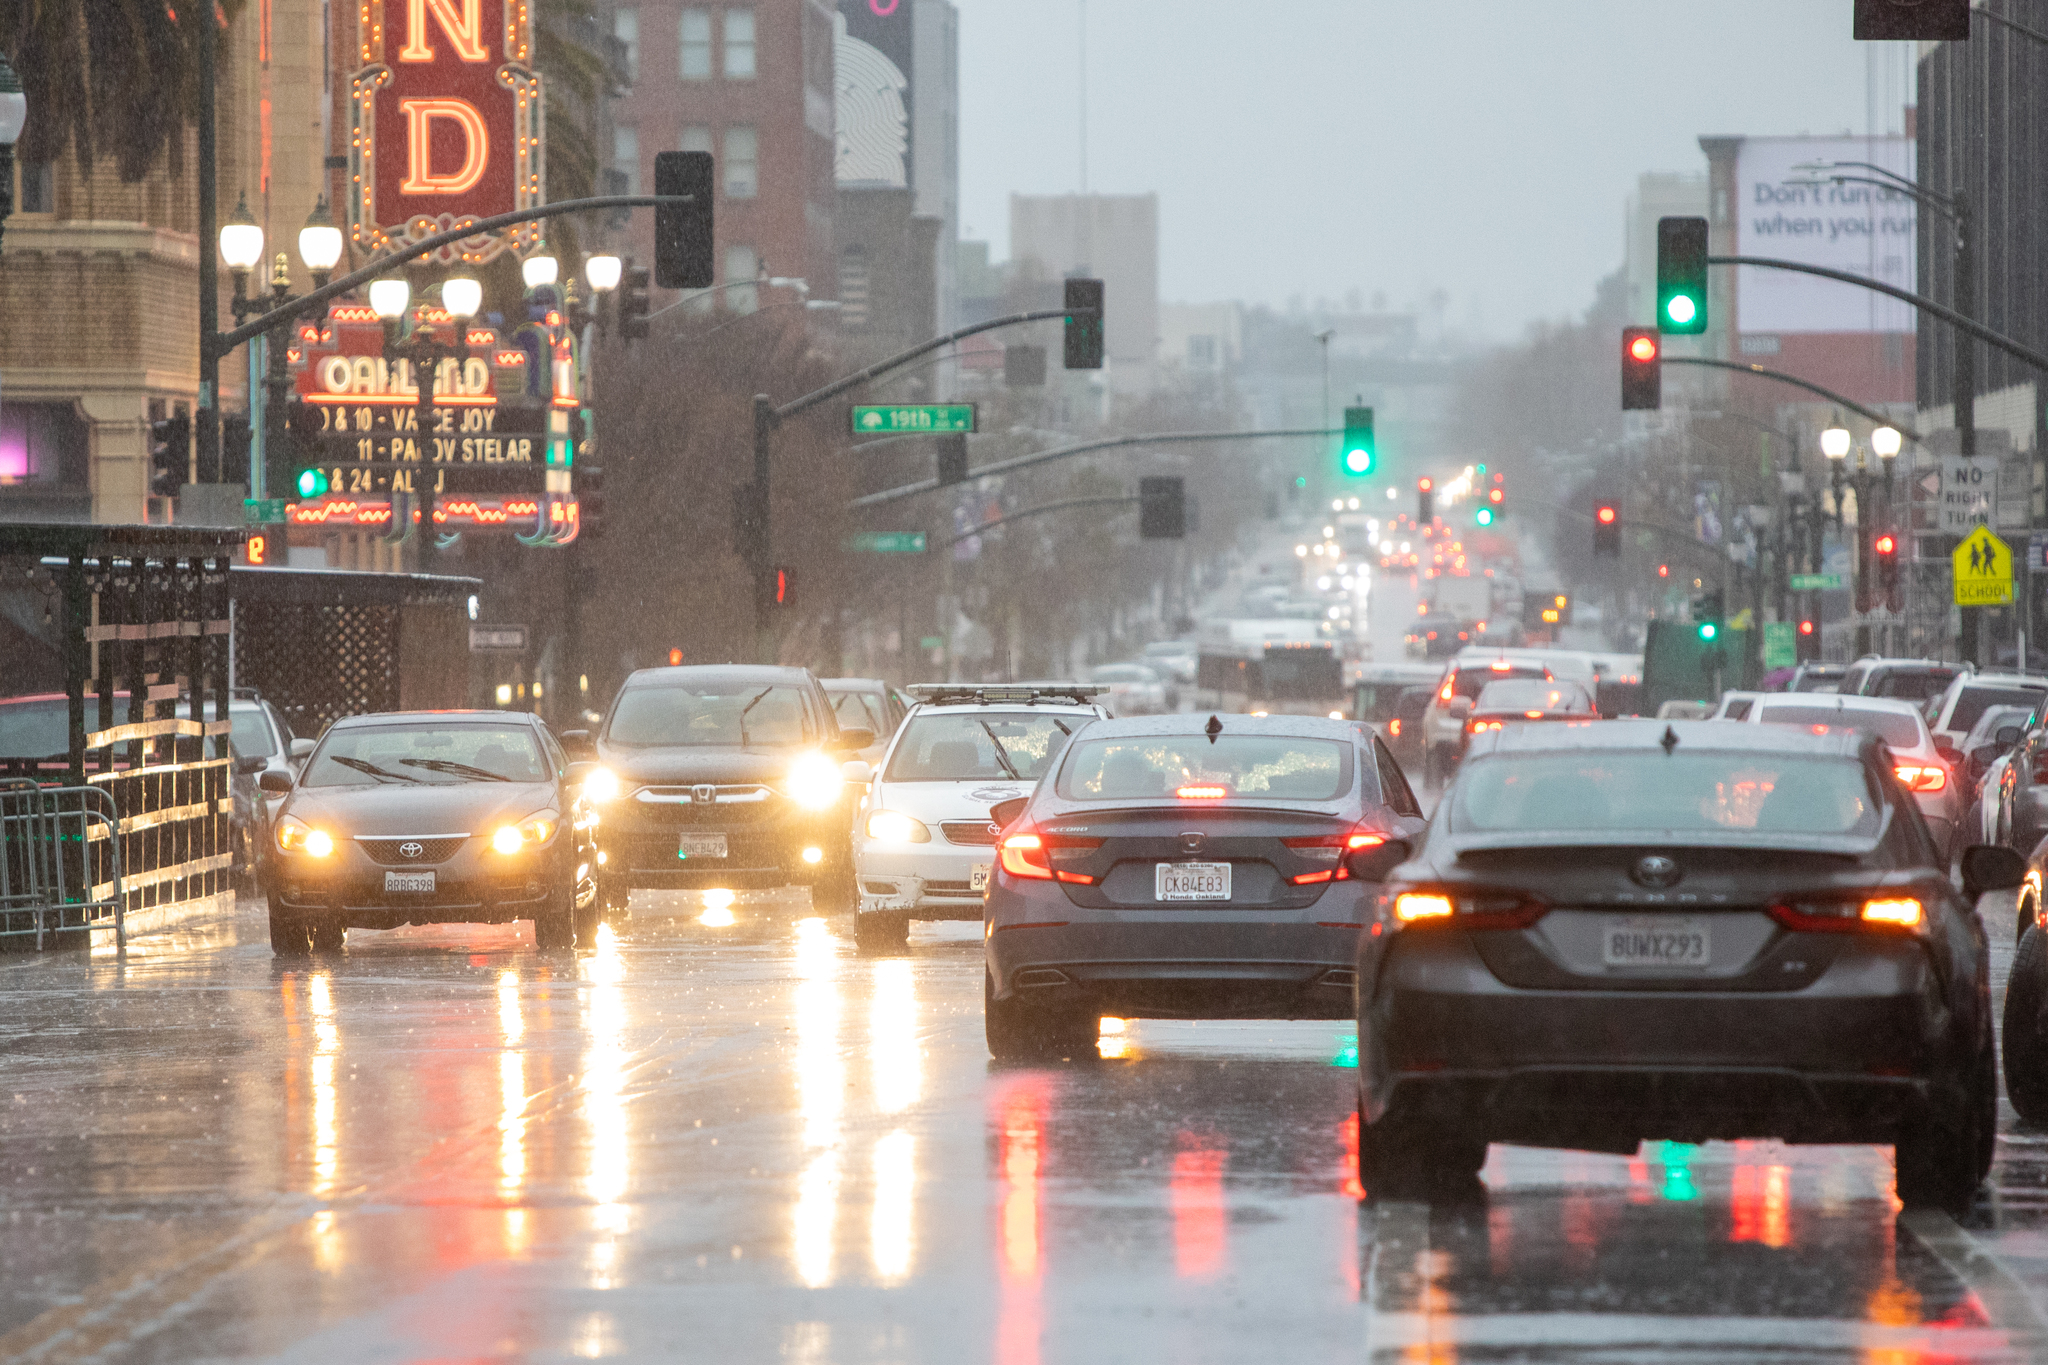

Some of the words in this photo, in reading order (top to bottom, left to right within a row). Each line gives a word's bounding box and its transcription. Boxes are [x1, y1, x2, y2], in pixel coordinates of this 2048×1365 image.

[1830, 186, 1870, 203] run
[1755, 212, 1823, 234] when
[1830, 217, 1874, 241] you
[355, 406, 373, 432] 10
[460, 407, 496, 433] JOY
[890, 410, 931, 427] 19th
[357, 437, 373, 462] 11
[462, 438, 532, 463] STELAR
[350, 468, 372, 494] 24
[1955, 467, 1983, 484] NO
[1960, 584, 2007, 599] SCHOOL
[387, 879, 433, 891] 8RBG398
[1165, 876, 1223, 892] CK84E83
[1612, 932, 1704, 959] 8UWX293
